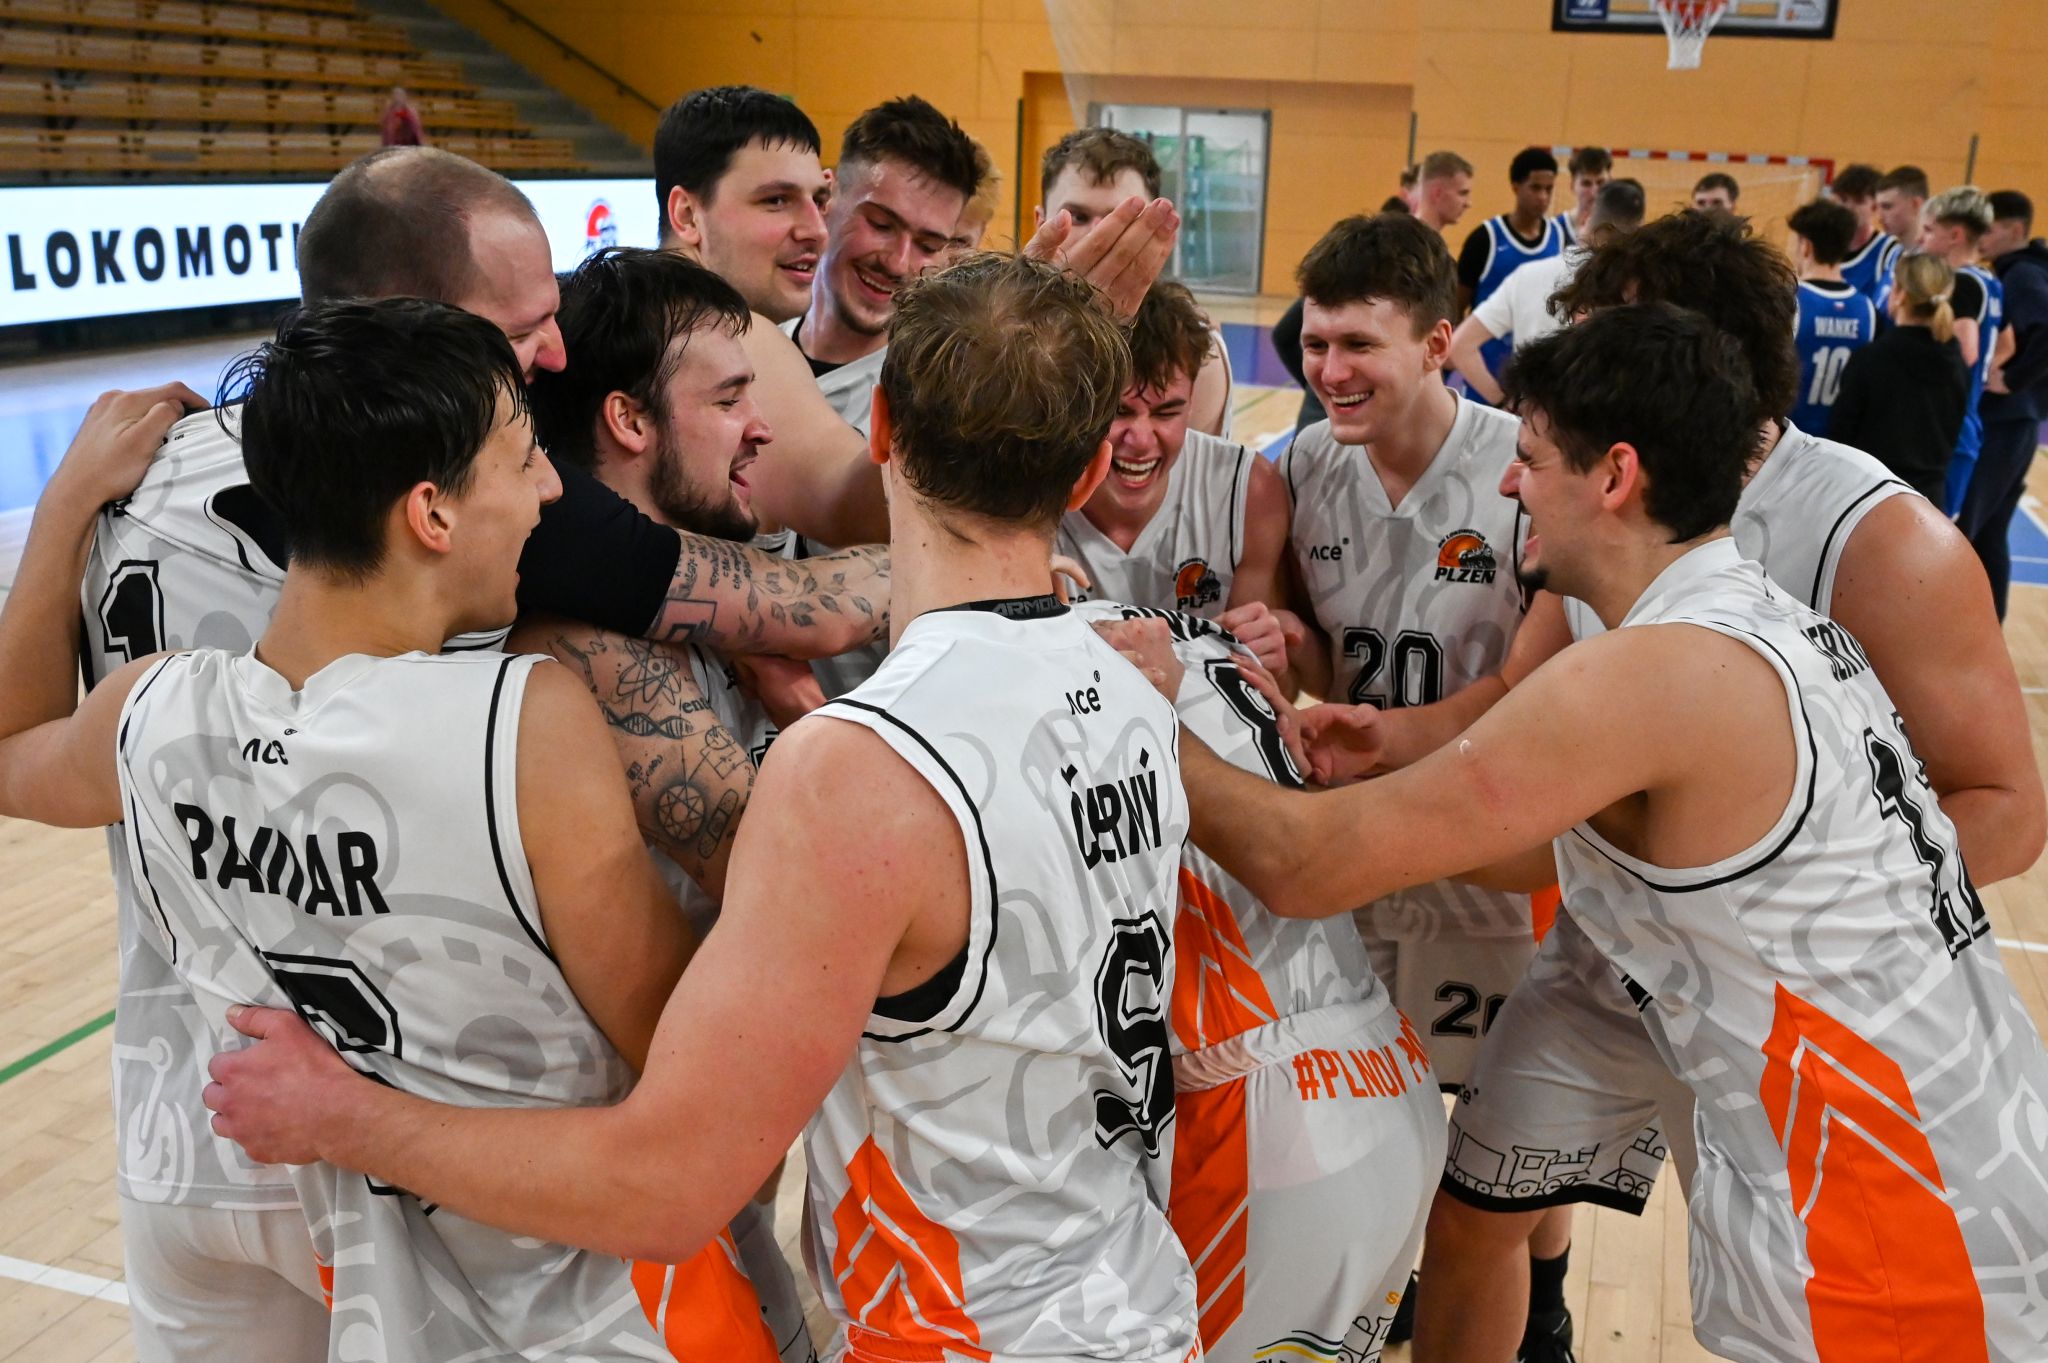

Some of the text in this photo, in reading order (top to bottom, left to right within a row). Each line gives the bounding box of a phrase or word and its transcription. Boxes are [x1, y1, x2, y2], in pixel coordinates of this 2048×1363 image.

[1807, 346, 1851, 405] 10
[1434, 567, 1497, 584] PLZEN
[1343, 627, 1443, 711] 20
